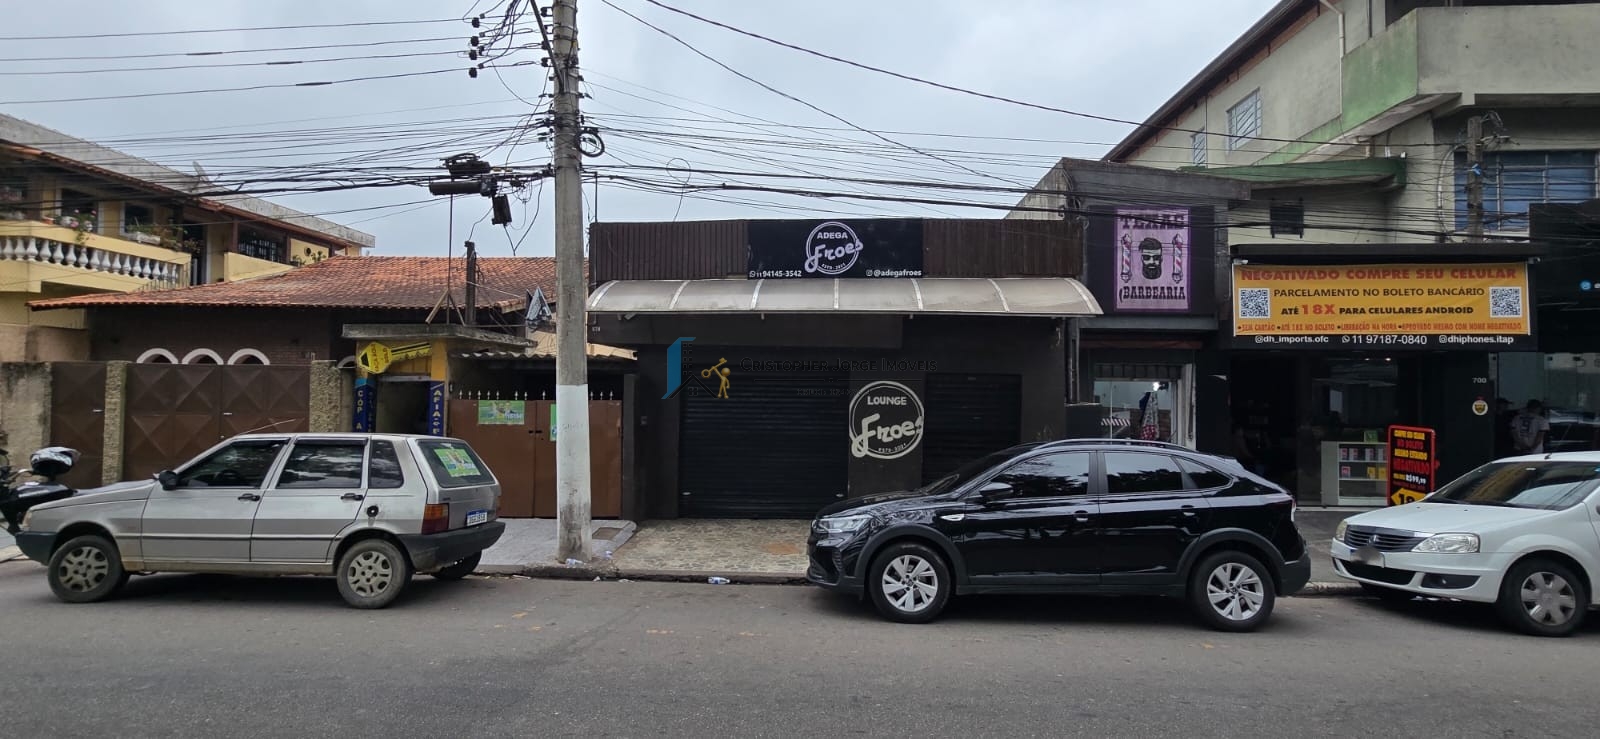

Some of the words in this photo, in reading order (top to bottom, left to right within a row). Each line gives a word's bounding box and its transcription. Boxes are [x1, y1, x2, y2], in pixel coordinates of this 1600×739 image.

[817, 232, 848, 240] ADEGA
[804, 239, 864, 273] Froes
[874, 269, 922, 278] @adegafroes
[1241, 270, 1339, 280] NEGATIVADO
[1345, 269, 1409, 280] COMPRE
[1416, 268, 1444, 279] SEU
[1450, 268, 1516, 279] CELULAR
[1123, 286, 1186, 300] BARBEARIA
[1273, 288, 1359, 297] PARCELAMENTO
[1362, 288, 1379, 297] NO
[1383, 288, 1424, 297] BOLETO
[1427, 286, 1485, 296] BANCÁRIO
[1281, 306, 1299, 315] ATÉ
[1301, 304, 1336, 315] 18X
[1339, 307, 1366, 315] PARA
[1368, 307, 1423, 315] CELULARES
[1425, 306, 1473, 314] ANDROID
[1255, 335, 1329, 344] @dh_imports.ofc
[1352, 335, 1362, 343] 11
[1365, 335, 1427, 344] 97187-0840
[1438, 335, 1514, 345] @dhiphones.itap
[867, 396, 907, 405] LOUNGE
